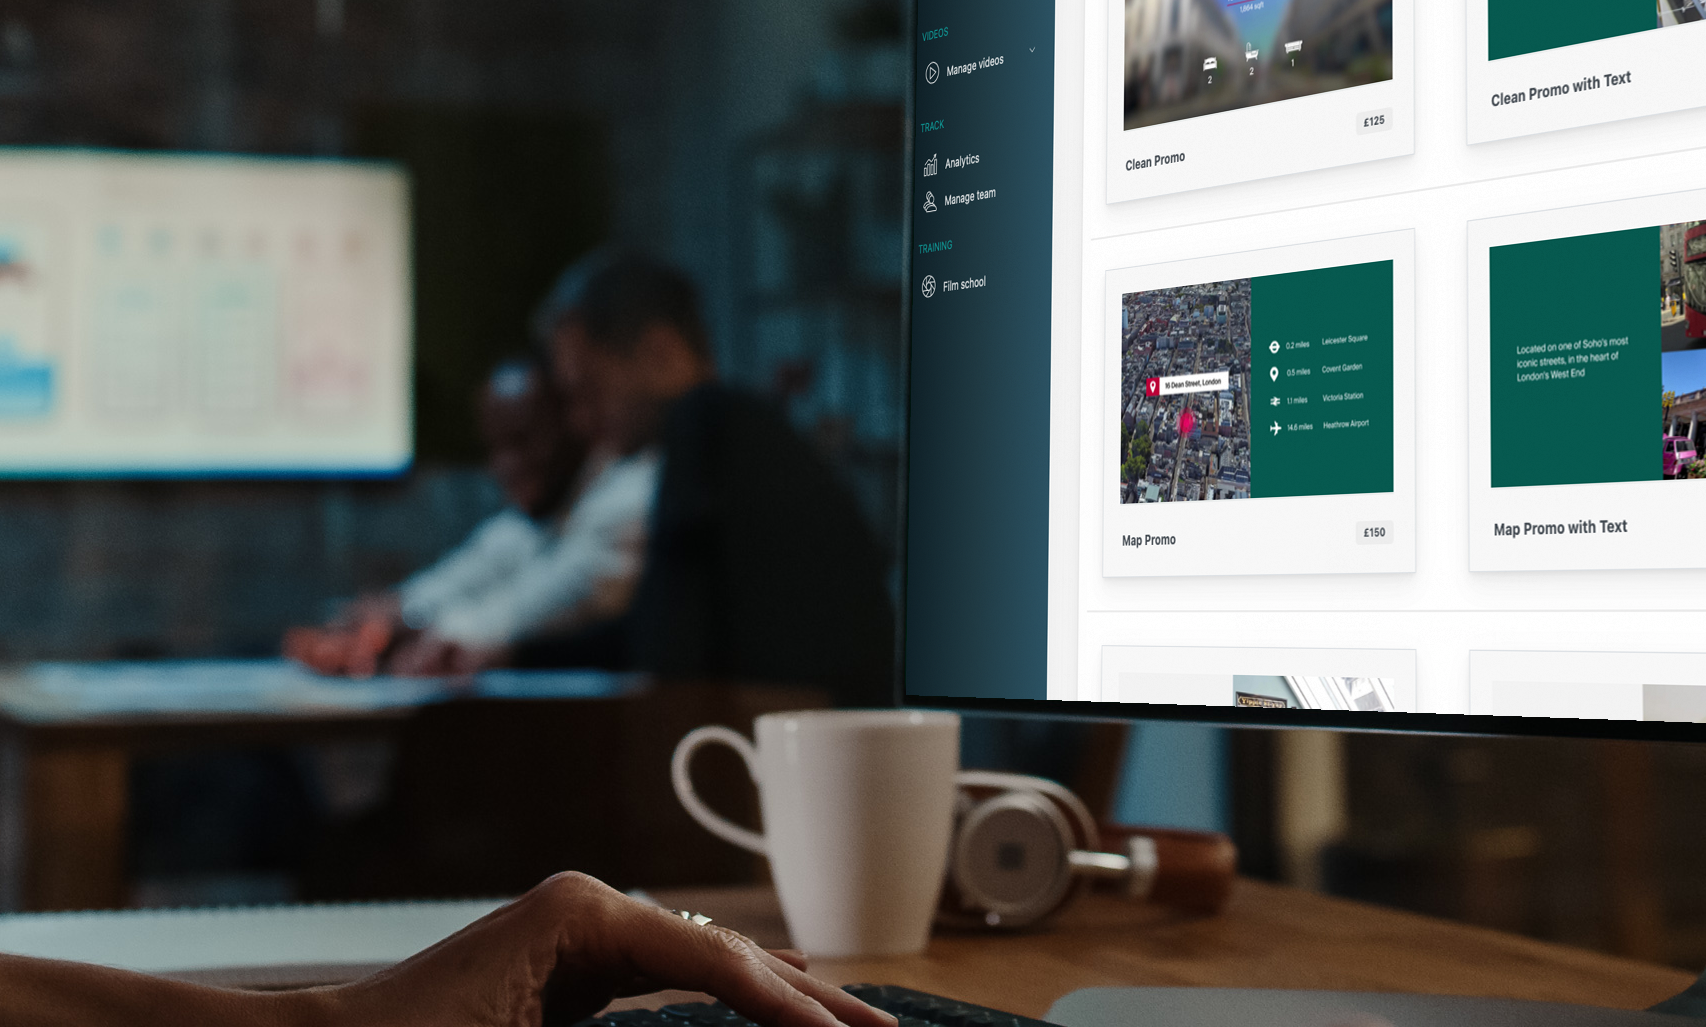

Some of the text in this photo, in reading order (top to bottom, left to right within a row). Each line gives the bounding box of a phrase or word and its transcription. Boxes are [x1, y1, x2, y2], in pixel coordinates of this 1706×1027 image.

[922, 27, 948, 41] VIDEOS
[947, 55, 1004, 77] Manage videos
[1208, 59, 1294, 84] 2 2 1
[1491, 71, 1632, 107] Clean Promo with Text
[921, 119, 945, 132] TRACK
[1363, 115, 1385, 128] £125
[945, 154, 979, 169] Analytics
[1125, 152, 1185, 172] Clean Promo
[945, 189, 996, 206] Manage team
[918, 240, 953, 254] TRAINING
[943, 275, 986, 292] Film school
[1295, 341, 1310, 349] miles
[1322, 334, 1368, 345] Leicester Square
[1517, 336, 1629, 355] Located on one of Soho's most
[1517, 351, 1619, 368] iconic streets, in the heart of
[1322, 363, 1362, 373] Covent Garden
[1517, 368, 1585, 382] London's West End
[1202, 378, 1221, 386] London
[1323, 392, 1364, 402] Victoria Station
[1323, 420, 1369, 429] Heathrow Airport
[1363, 527, 1386, 538] £150
[1494, 520, 1628, 538] Map Promo with Text
[1122, 534, 1176, 548] Map Promo
